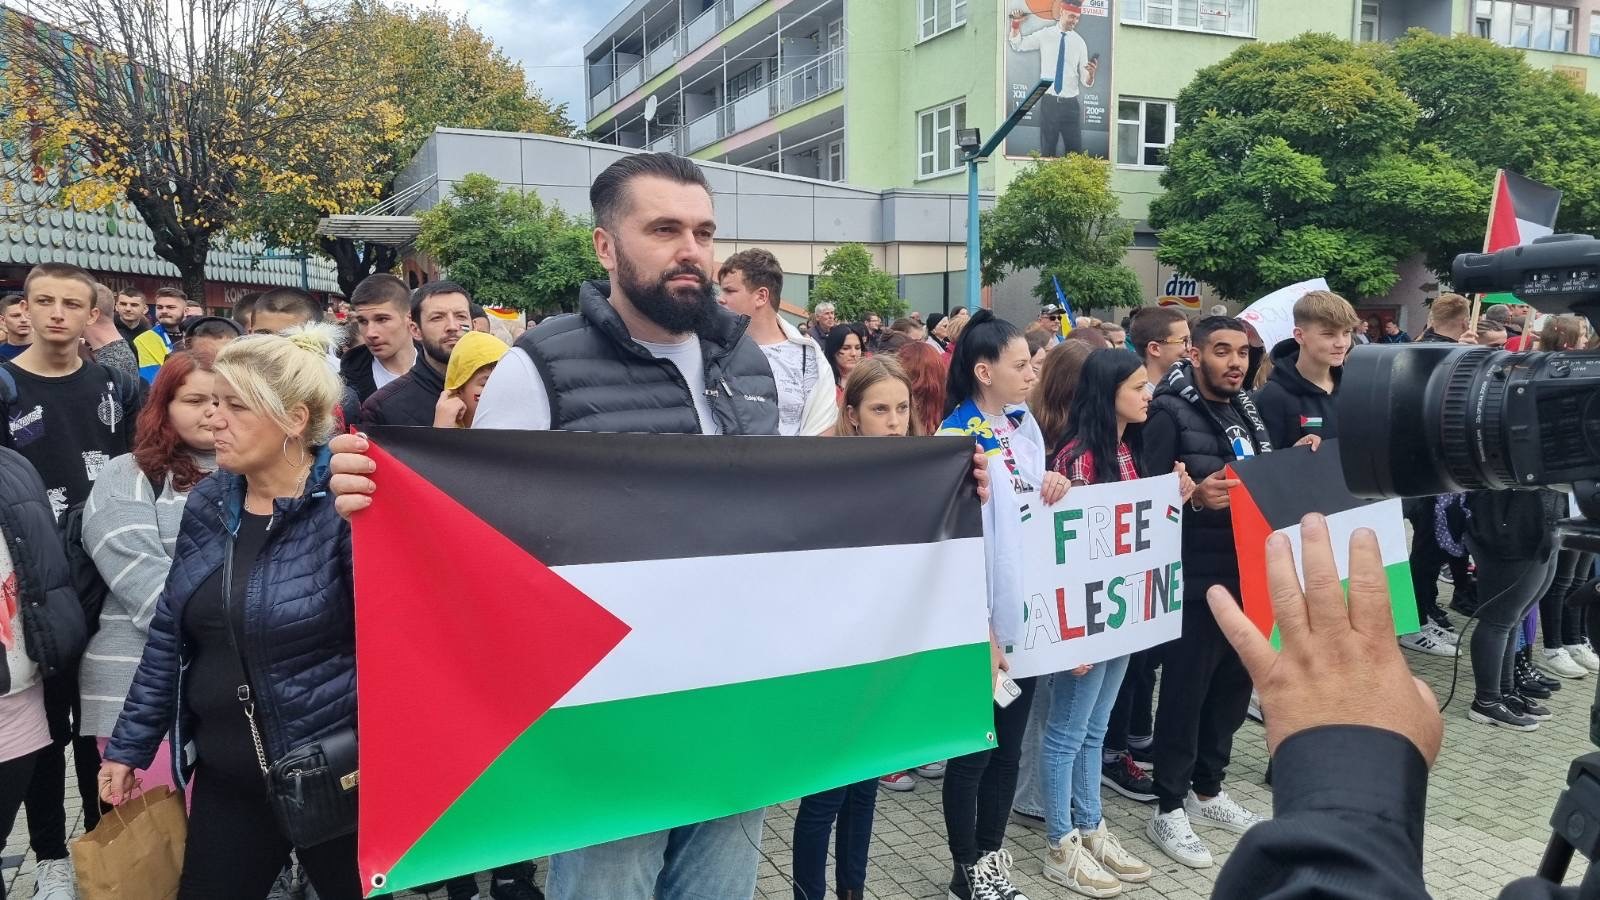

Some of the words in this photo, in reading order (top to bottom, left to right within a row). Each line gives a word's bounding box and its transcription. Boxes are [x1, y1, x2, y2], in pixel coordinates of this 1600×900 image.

[1165, 273, 1197, 297] dm
[1053, 499, 1153, 566] FREE
[1022, 560, 1182, 651] ALESTINE
